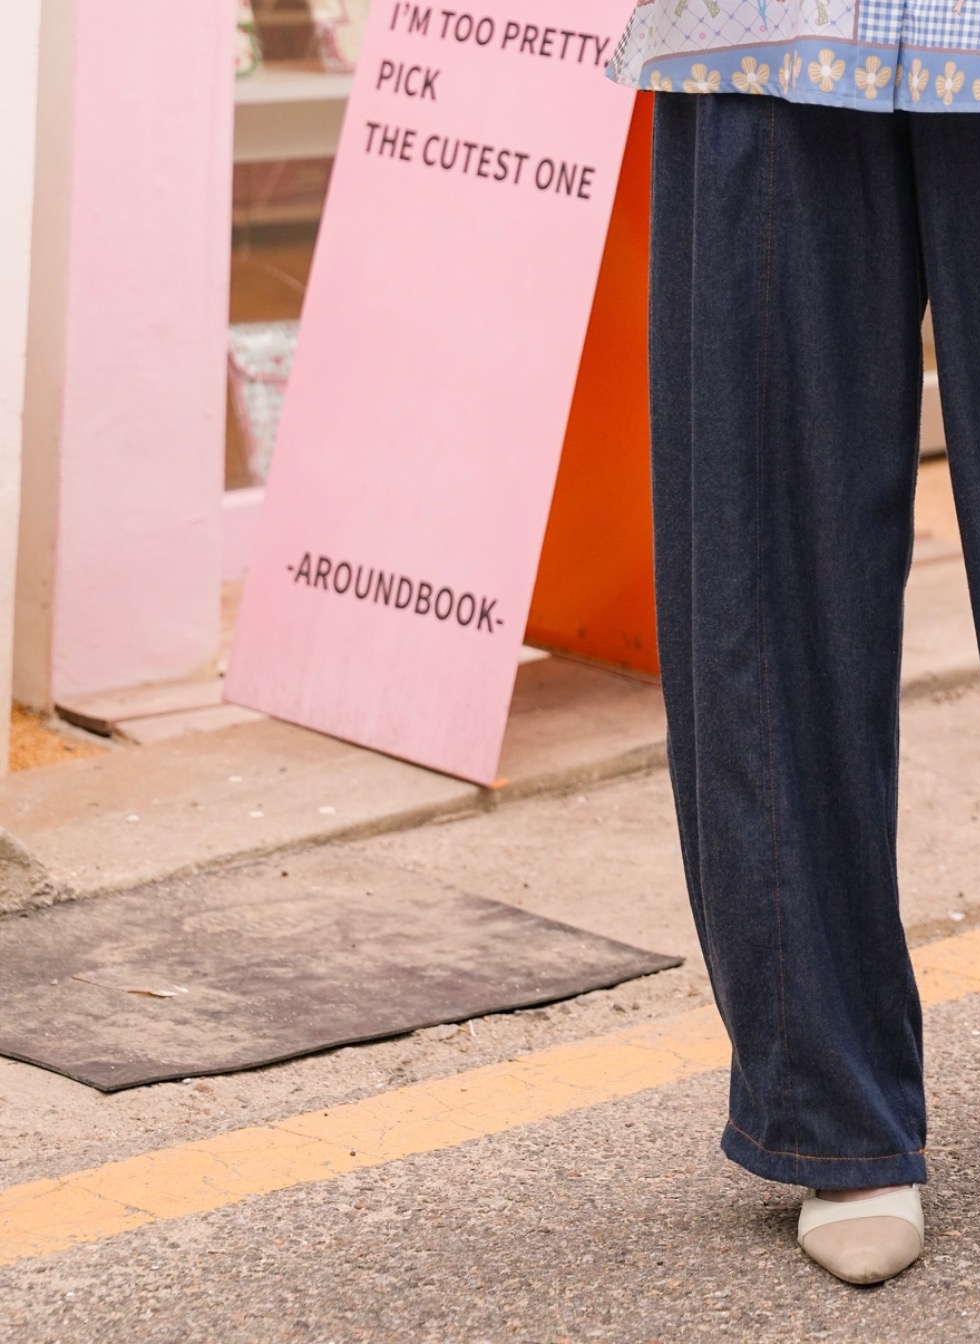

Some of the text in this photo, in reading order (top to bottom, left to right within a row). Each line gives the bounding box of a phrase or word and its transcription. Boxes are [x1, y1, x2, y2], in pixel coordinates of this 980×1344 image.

[390, 2, 431, 36] I'M
[441, 11, 494, 46] TOO
[376, 60, 441, 101] PICK
[363, 121, 596, 200] THE CUTEST ONE
